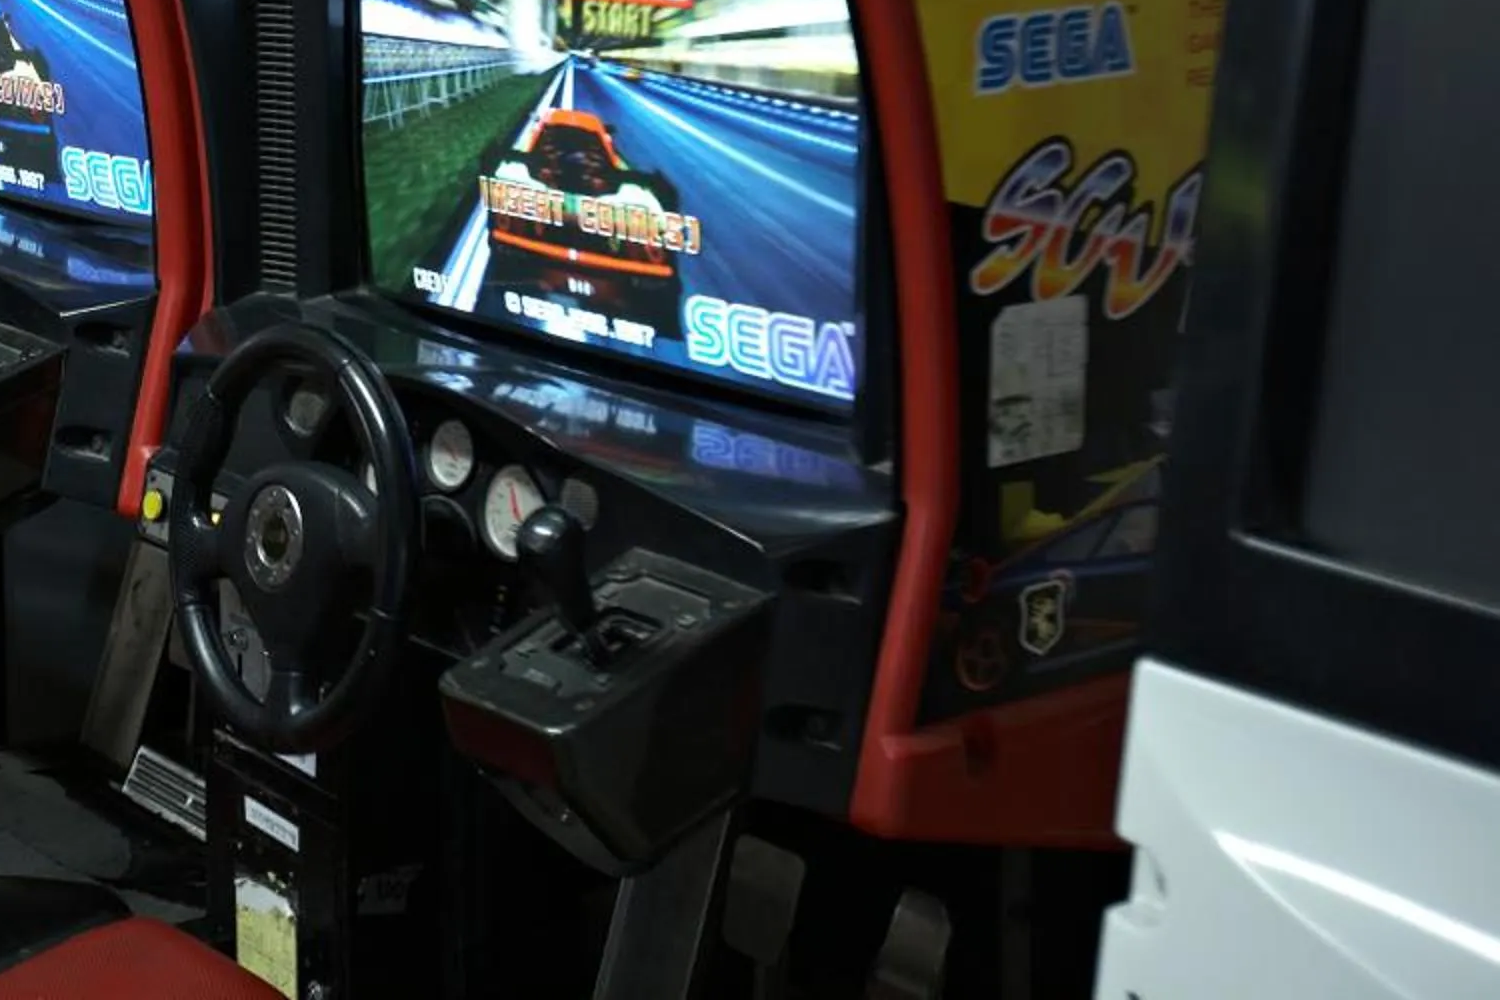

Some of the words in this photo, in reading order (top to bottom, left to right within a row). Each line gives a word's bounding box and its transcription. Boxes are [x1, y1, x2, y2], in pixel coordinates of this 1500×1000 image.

[975, 1, 1134, 94] SEGA
[478, 174, 565, 227] INSERT
[684, 294, 855, 400] SEGA
